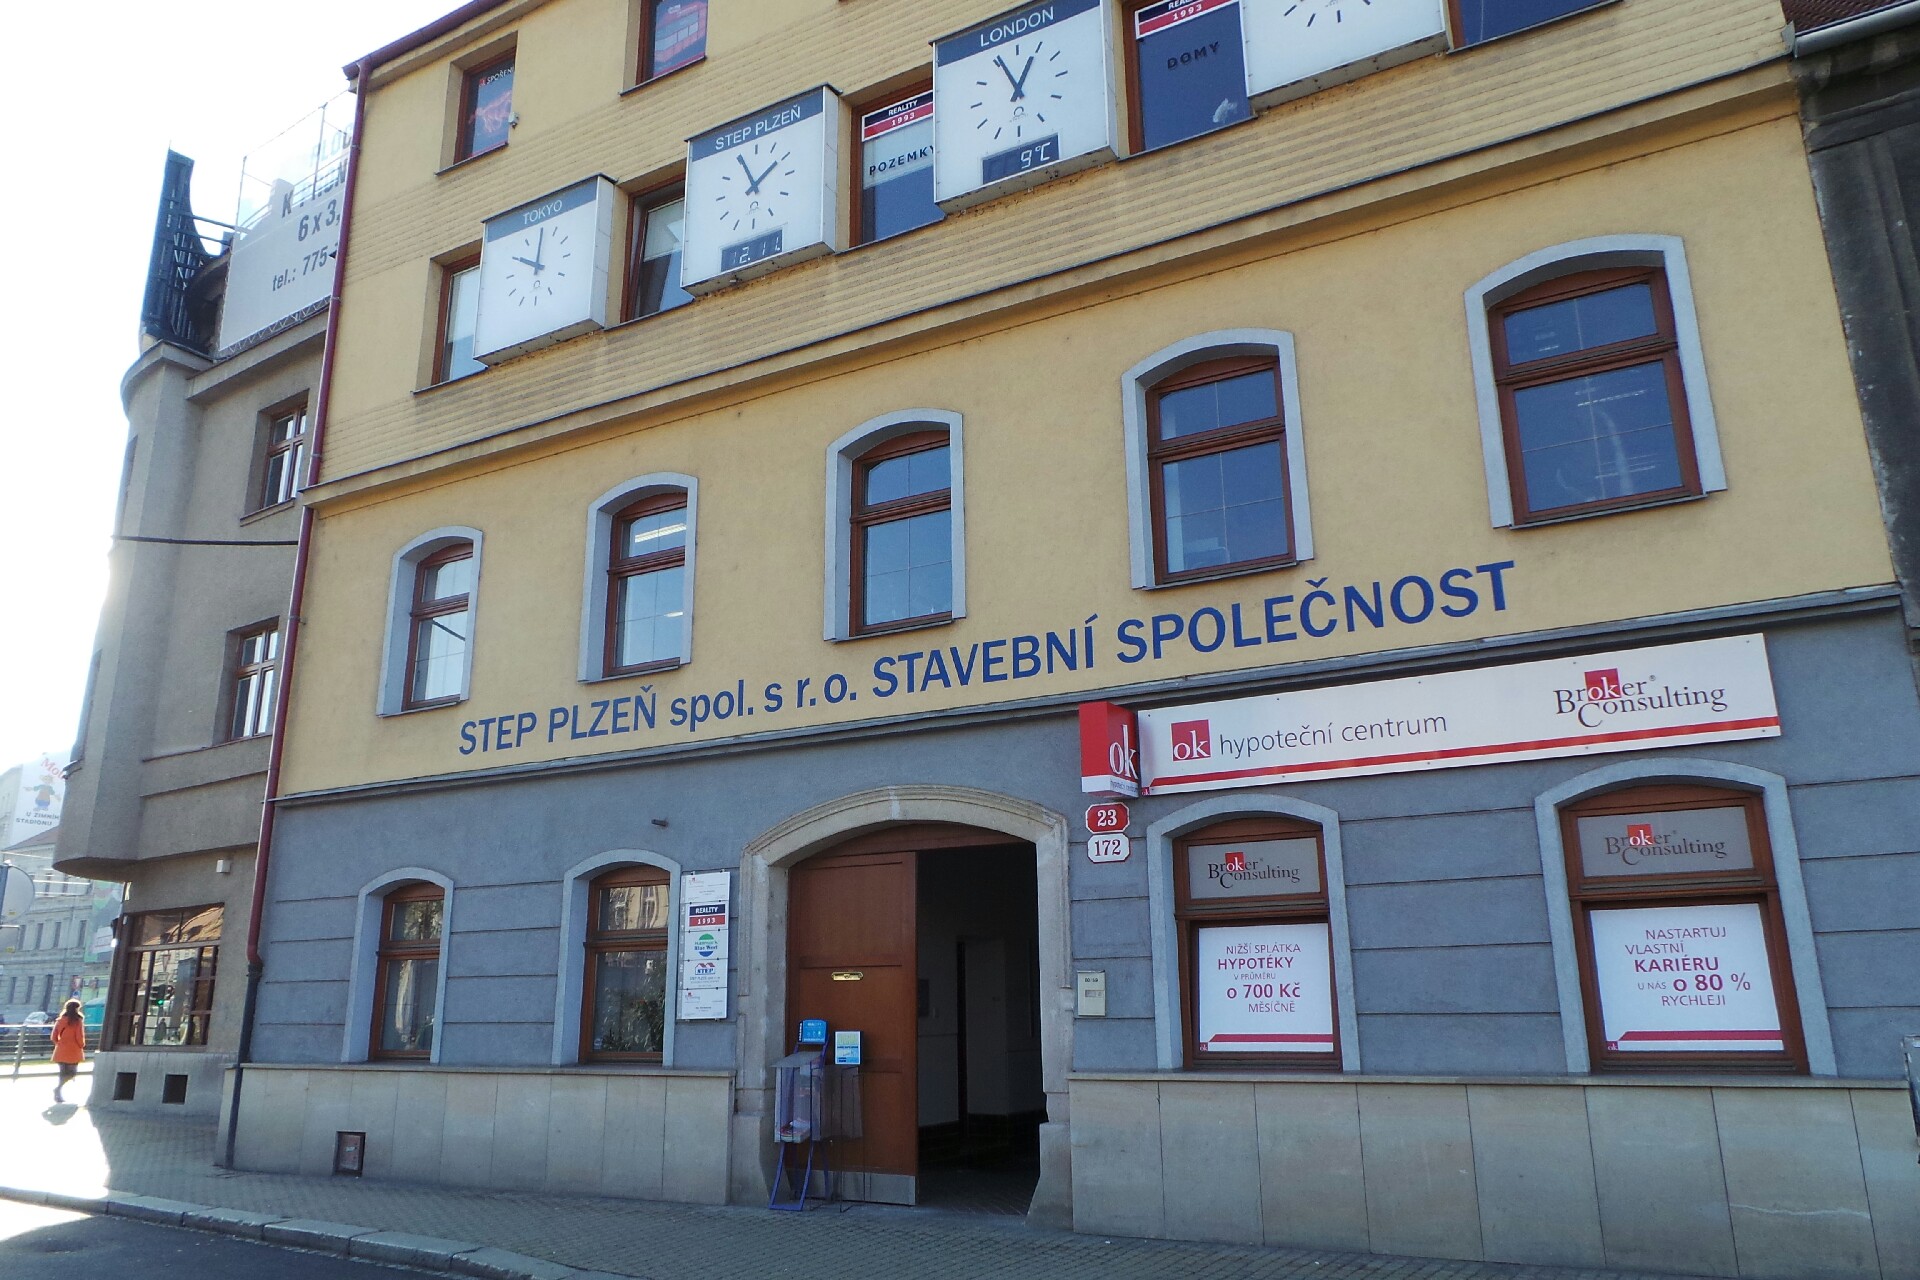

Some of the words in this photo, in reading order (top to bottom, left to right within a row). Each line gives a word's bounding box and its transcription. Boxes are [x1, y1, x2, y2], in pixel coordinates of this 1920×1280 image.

[1173, 4, 1202, 20] 1993
[980, 6, 1054, 47] LONDON
[1167, 41, 1220, 70] DOMY
[888, 100, 918, 116] REALITY
[715, 126, 751, 151] STEP
[755, 104, 801, 136] PLZEŇ
[892, 112, 915, 126] 1993
[869, 145, 934, 175] POZEMKY
[523, 199, 562, 224] TOKYO
[298, 214, 309, 241] 6
[272, 268, 296, 291] tel.:
[302, 246, 328, 276] 775
[458, 711, 537, 755] STEP
[548, 685, 657, 743] PLZEŇ
[669, 679, 754, 732] spol.
[764, 682, 783, 712] s
[797, 673, 857, 708] r.o.
[872, 613, 1098, 698] STAVEBNÍ
[1116, 560, 1515, 664] SPOLEČNOST
[1578, 686, 1727, 728] Consulting
[1173, 730, 1210, 761] ok
[1219, 722, 1333, 759] hypoteční
[1341, 714, 1447, 743] centrum
[1109, 724, 1138, 780] ok
[16, 817, 53, 826] STADIONU
[1097, 809, 1117, 827] 23
[1094, 839, 1121, 857] 172
[1621, 838, 1728, 866] Consulting
[1219, 866, 1301, 889] Consulting
[695, 906, 718, 914] REALITY
[697, 917, 715, 925] 1993
[1645, 926, 1726, 940] NASTARTUJ
[1226, 942, 1252, 955] NIŽŠÍ
[1254, 942, 1301, 953] SPLÁTKA
[1624, 940, 1684, 955] VLASTNÍ
[1217, 954, 1294, 971] HYPOTÉKY
[1634, 954, 1719, 973] KARIÉRU
[1240, 971, 1276, 980] PRŮMĚRU
[1637, 982, 1645, 990] U
[1647, 980, 1667, 990] NÁS
[1694, 973, 1723, 991] 80
[1730, 972, 1751, 991] %
[1243, 984, 1273, 998] 700
[1279, 981, 1301, 998] Kč
[1248, 1001, 1296, 1013] MĚSÍČNĚ
[1661, 994, 1726, 1007] RYCHLEJI
